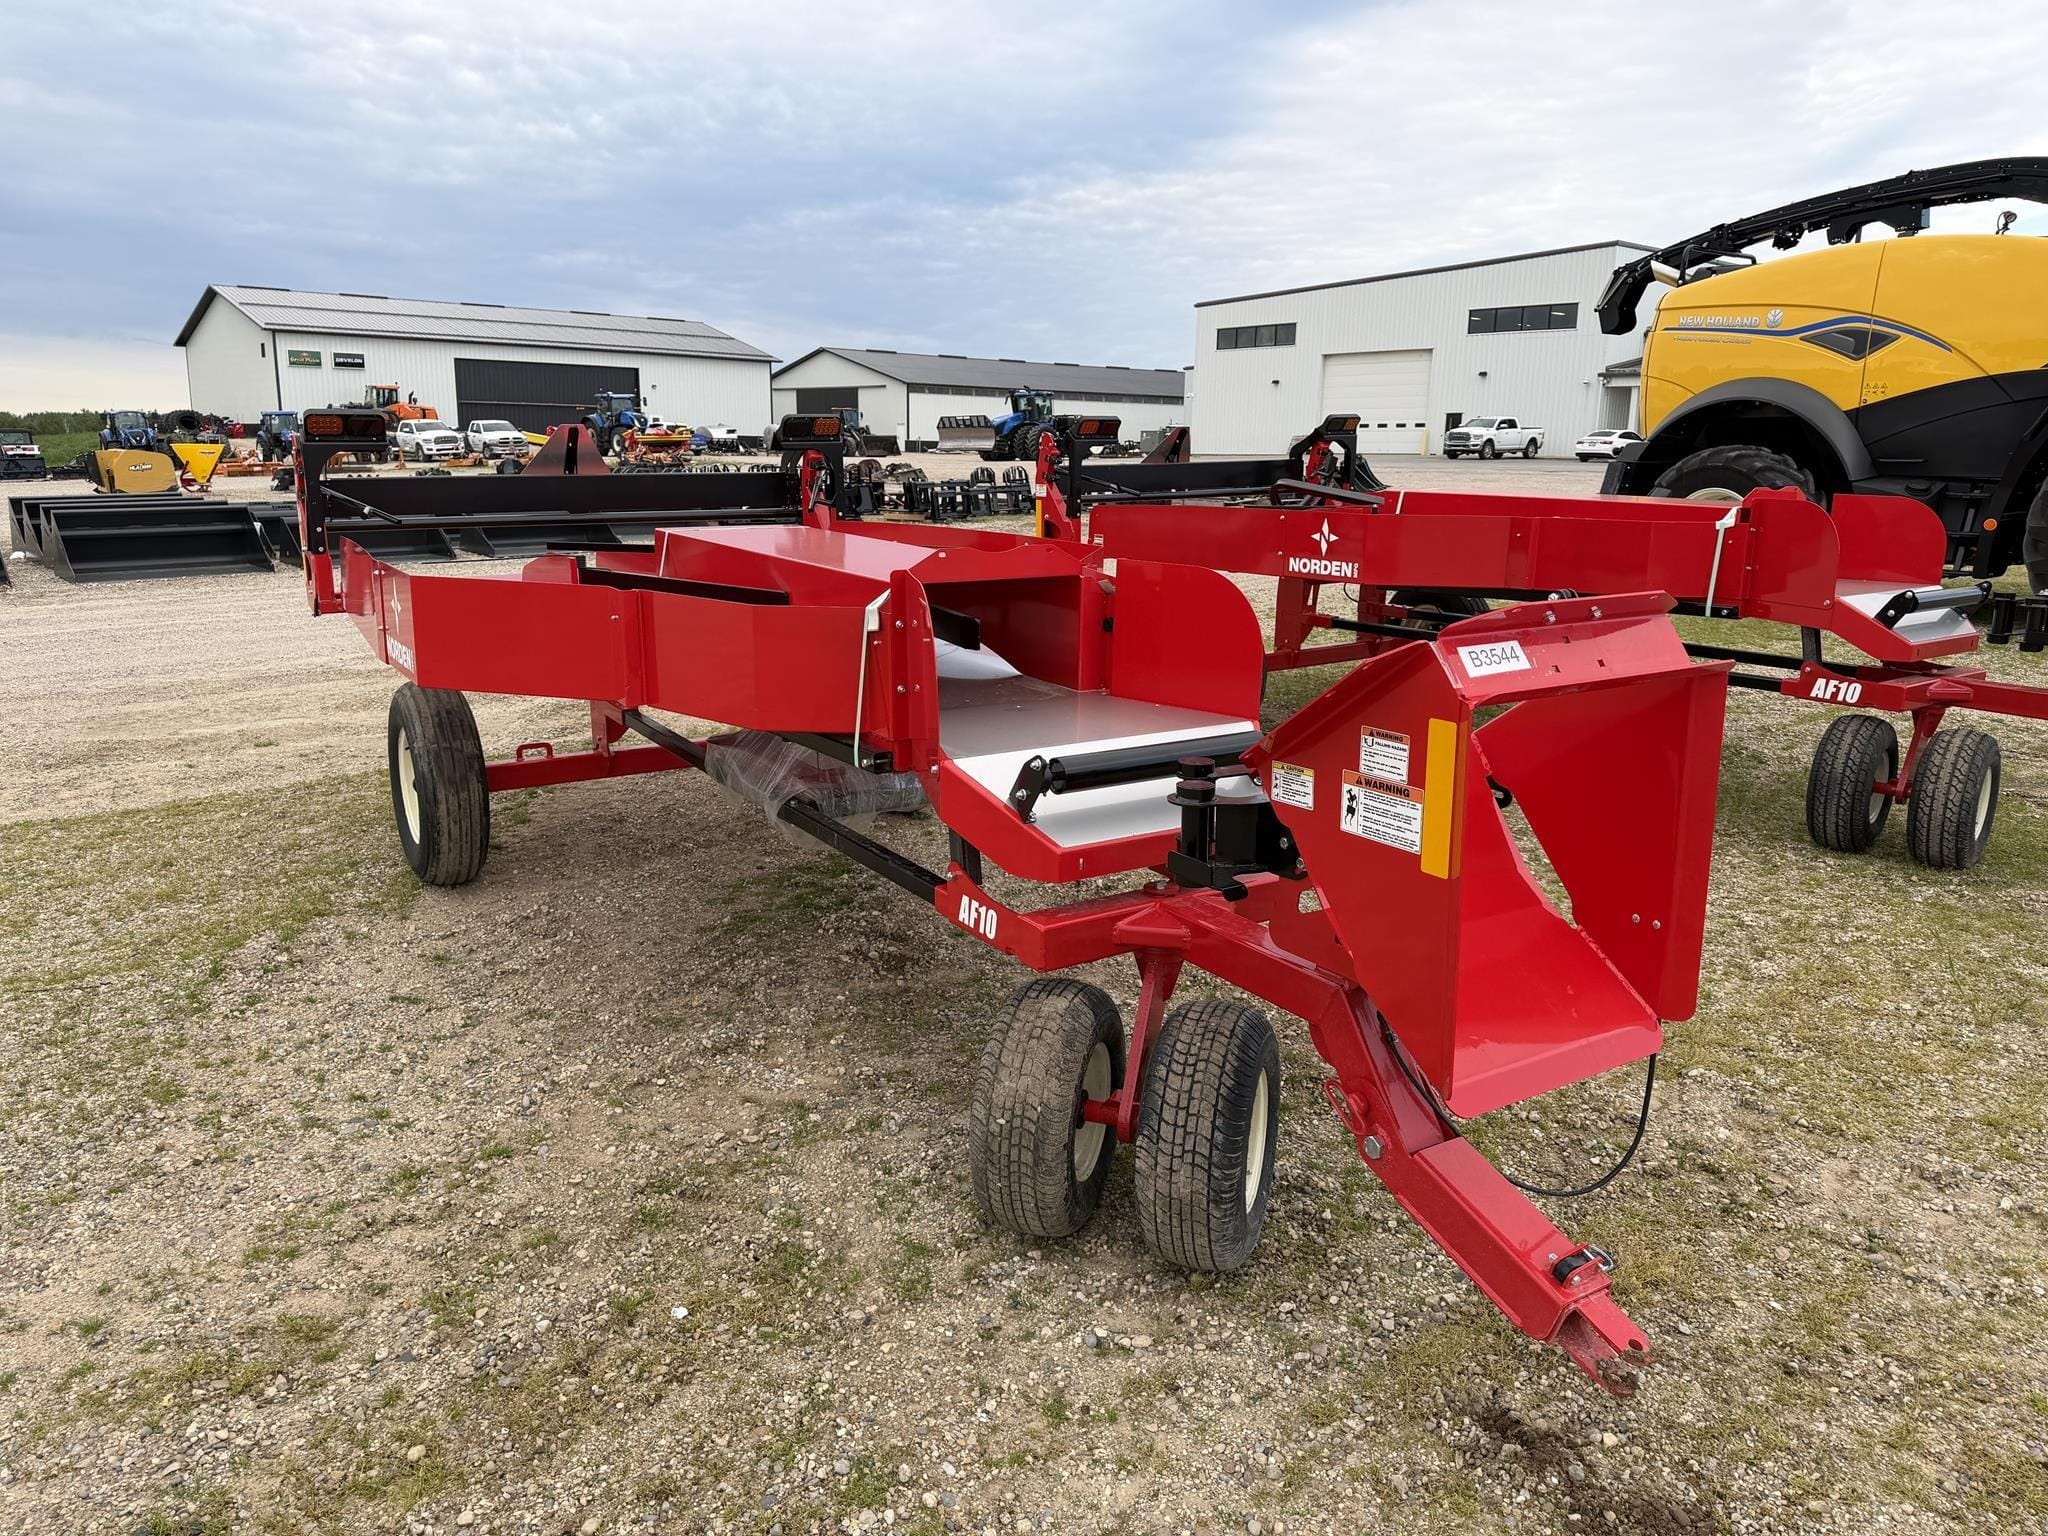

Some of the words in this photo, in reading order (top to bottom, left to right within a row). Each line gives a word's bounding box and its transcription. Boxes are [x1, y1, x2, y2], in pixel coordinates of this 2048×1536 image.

[1679, 316, 1704, 327] NEW
[1705, 316, 1760, 328] HOLLAND
[1288, 556, 1353, 578] NORDEN
[1468, 645, 1520, 667] B3544
[1810, 677, 1862, 704] AF10
[1375, 731, 1403, 743] WARNING
[1364, 778, 1410, 798] WARNING
[958, 894, 998, 940] AF10
